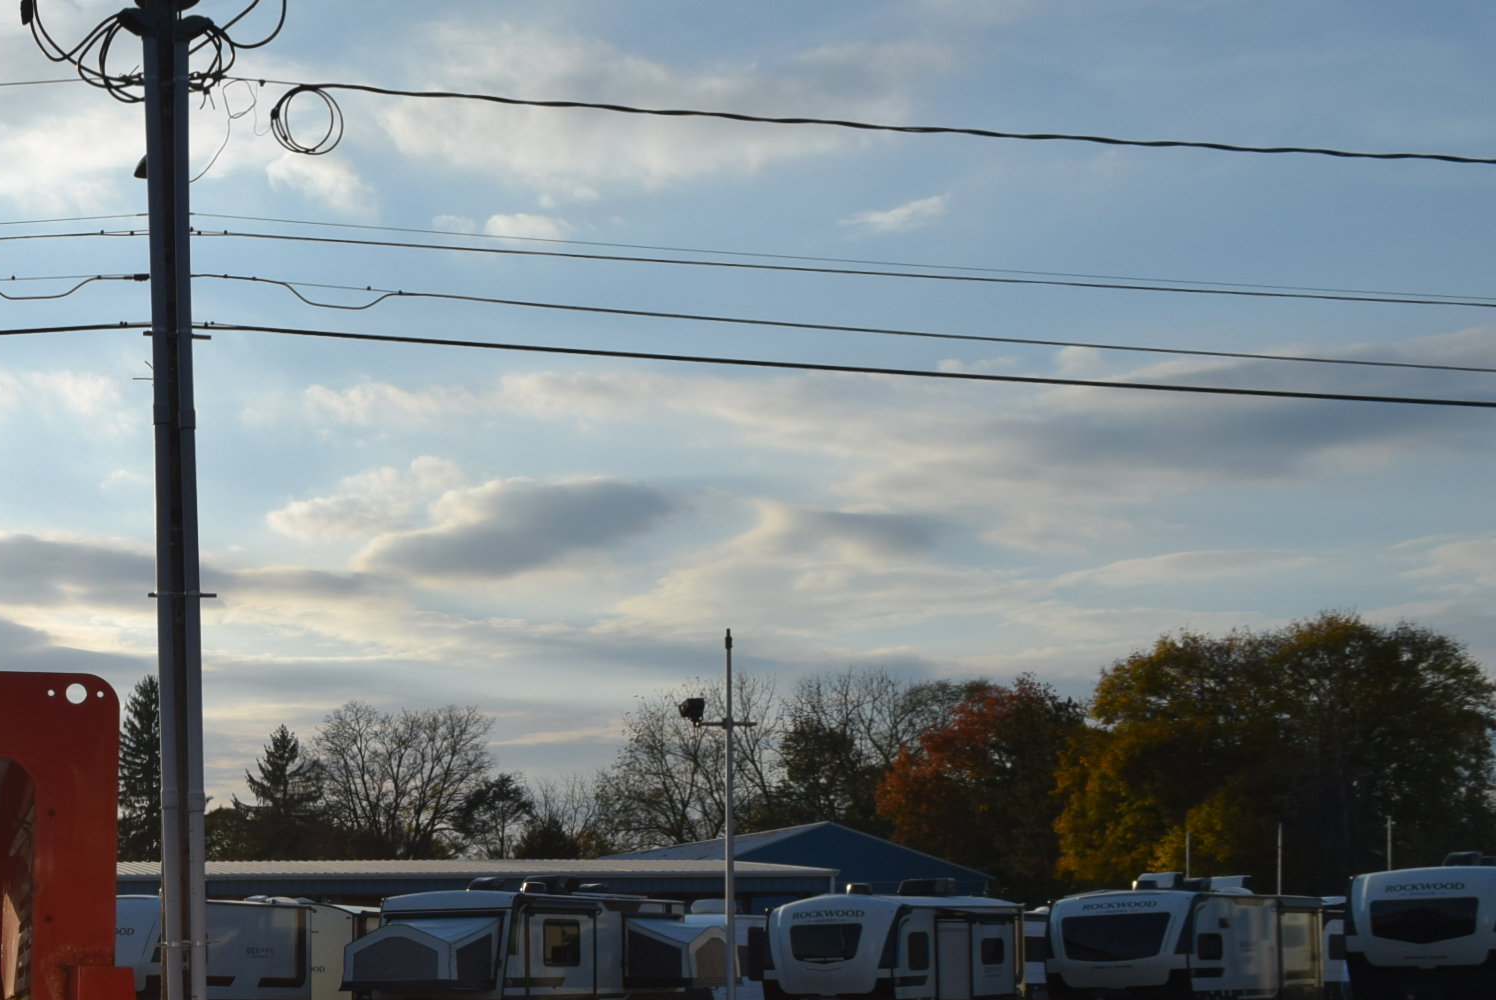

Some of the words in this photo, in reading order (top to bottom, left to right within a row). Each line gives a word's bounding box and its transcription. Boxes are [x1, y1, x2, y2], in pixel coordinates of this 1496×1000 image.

[1385, 882, 1465, 893] ROCKWOOD
[1082, 901, 1158, 911] ROCKWOOD
[792, 909, 865, 920] ROCKWOOD
